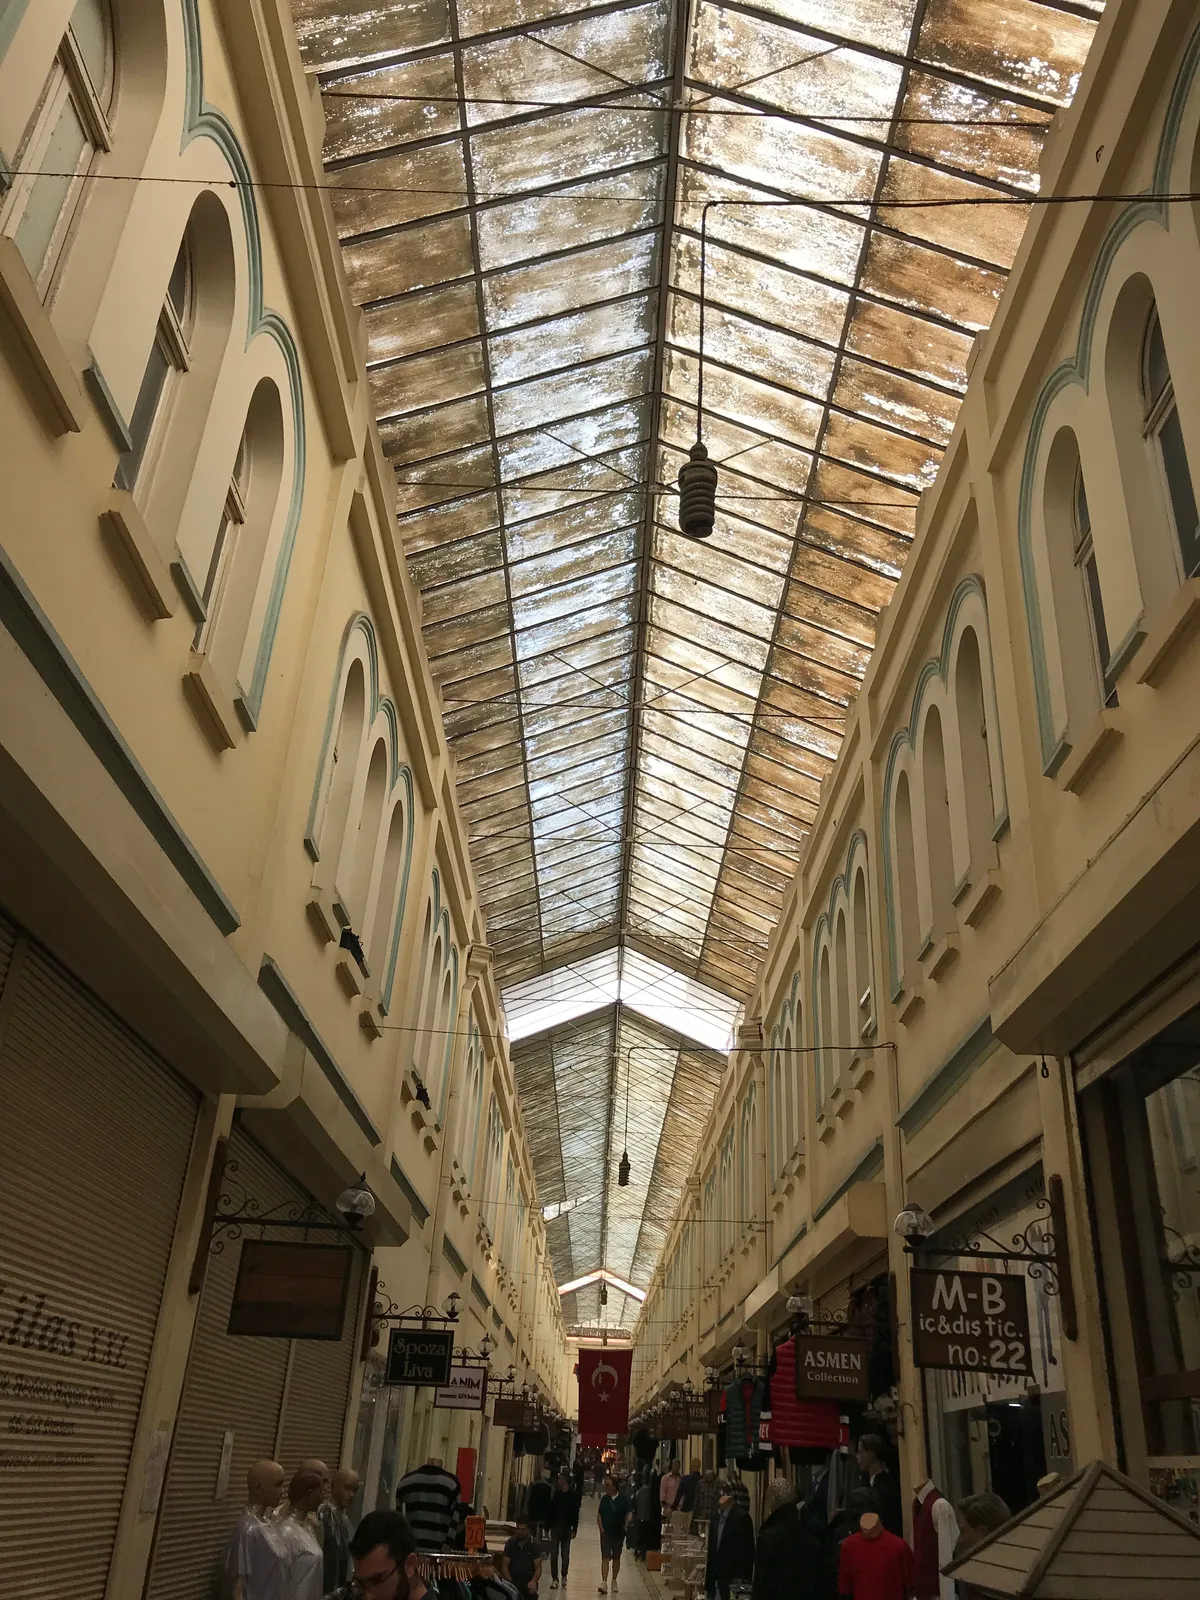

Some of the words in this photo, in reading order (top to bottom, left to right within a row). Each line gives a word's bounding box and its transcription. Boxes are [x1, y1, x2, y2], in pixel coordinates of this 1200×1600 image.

[932, 1274, 1006, 1315] M-B
[0, 1284, 82, 1357] ilas
[984, 1316, 1024, 1338] tic.
[394, 1338, 446, 1360] Spoza
[948, 1340, 1027, 1371] no:22
[402, 1361, 433, 1379] Liva
[804, 1350, 862, 1371] ASMEN
[807, 1371, 860, 1384] Collection
